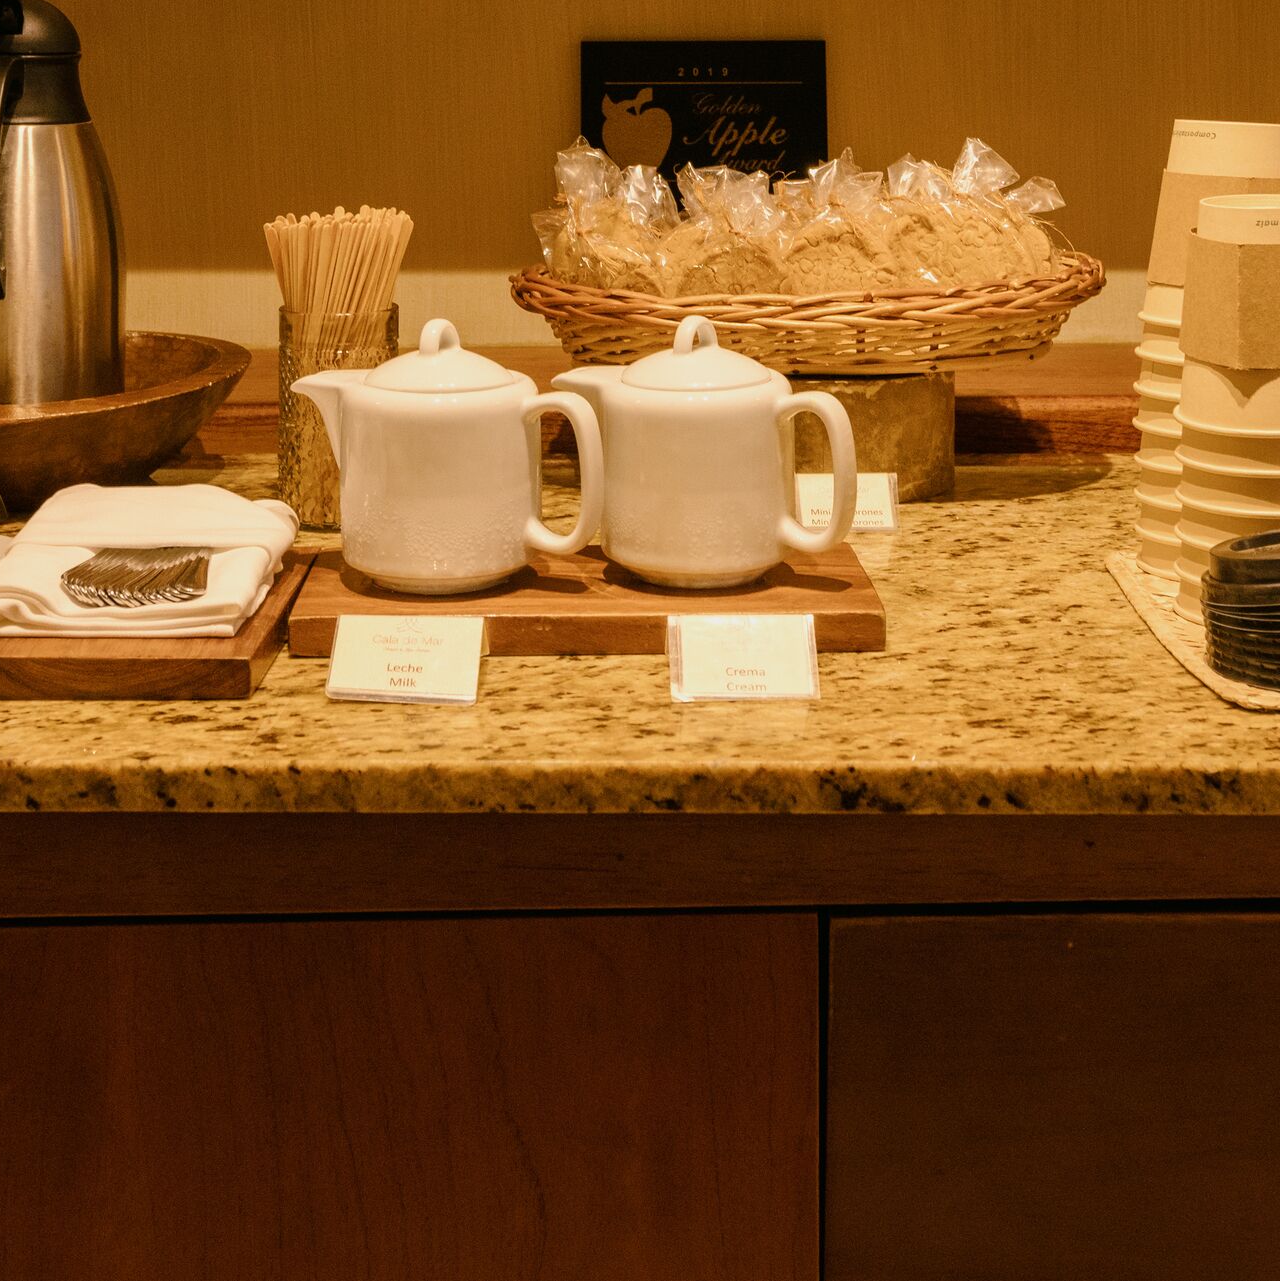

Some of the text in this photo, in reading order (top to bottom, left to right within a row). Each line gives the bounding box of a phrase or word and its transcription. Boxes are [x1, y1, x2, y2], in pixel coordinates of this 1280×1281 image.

[677, 67, 729, 77] 2019
[693, 93, 761, 114] Golden
[683, 115, 789, 156] Apple
[373, 634, 444, 645] Cala de Mar
[387, 663, 423, 673] Leche
[726, 667, 766, 677] Crema
[390, 678, 416, 688] Milk
[726, 682, 767, 691] Cream
